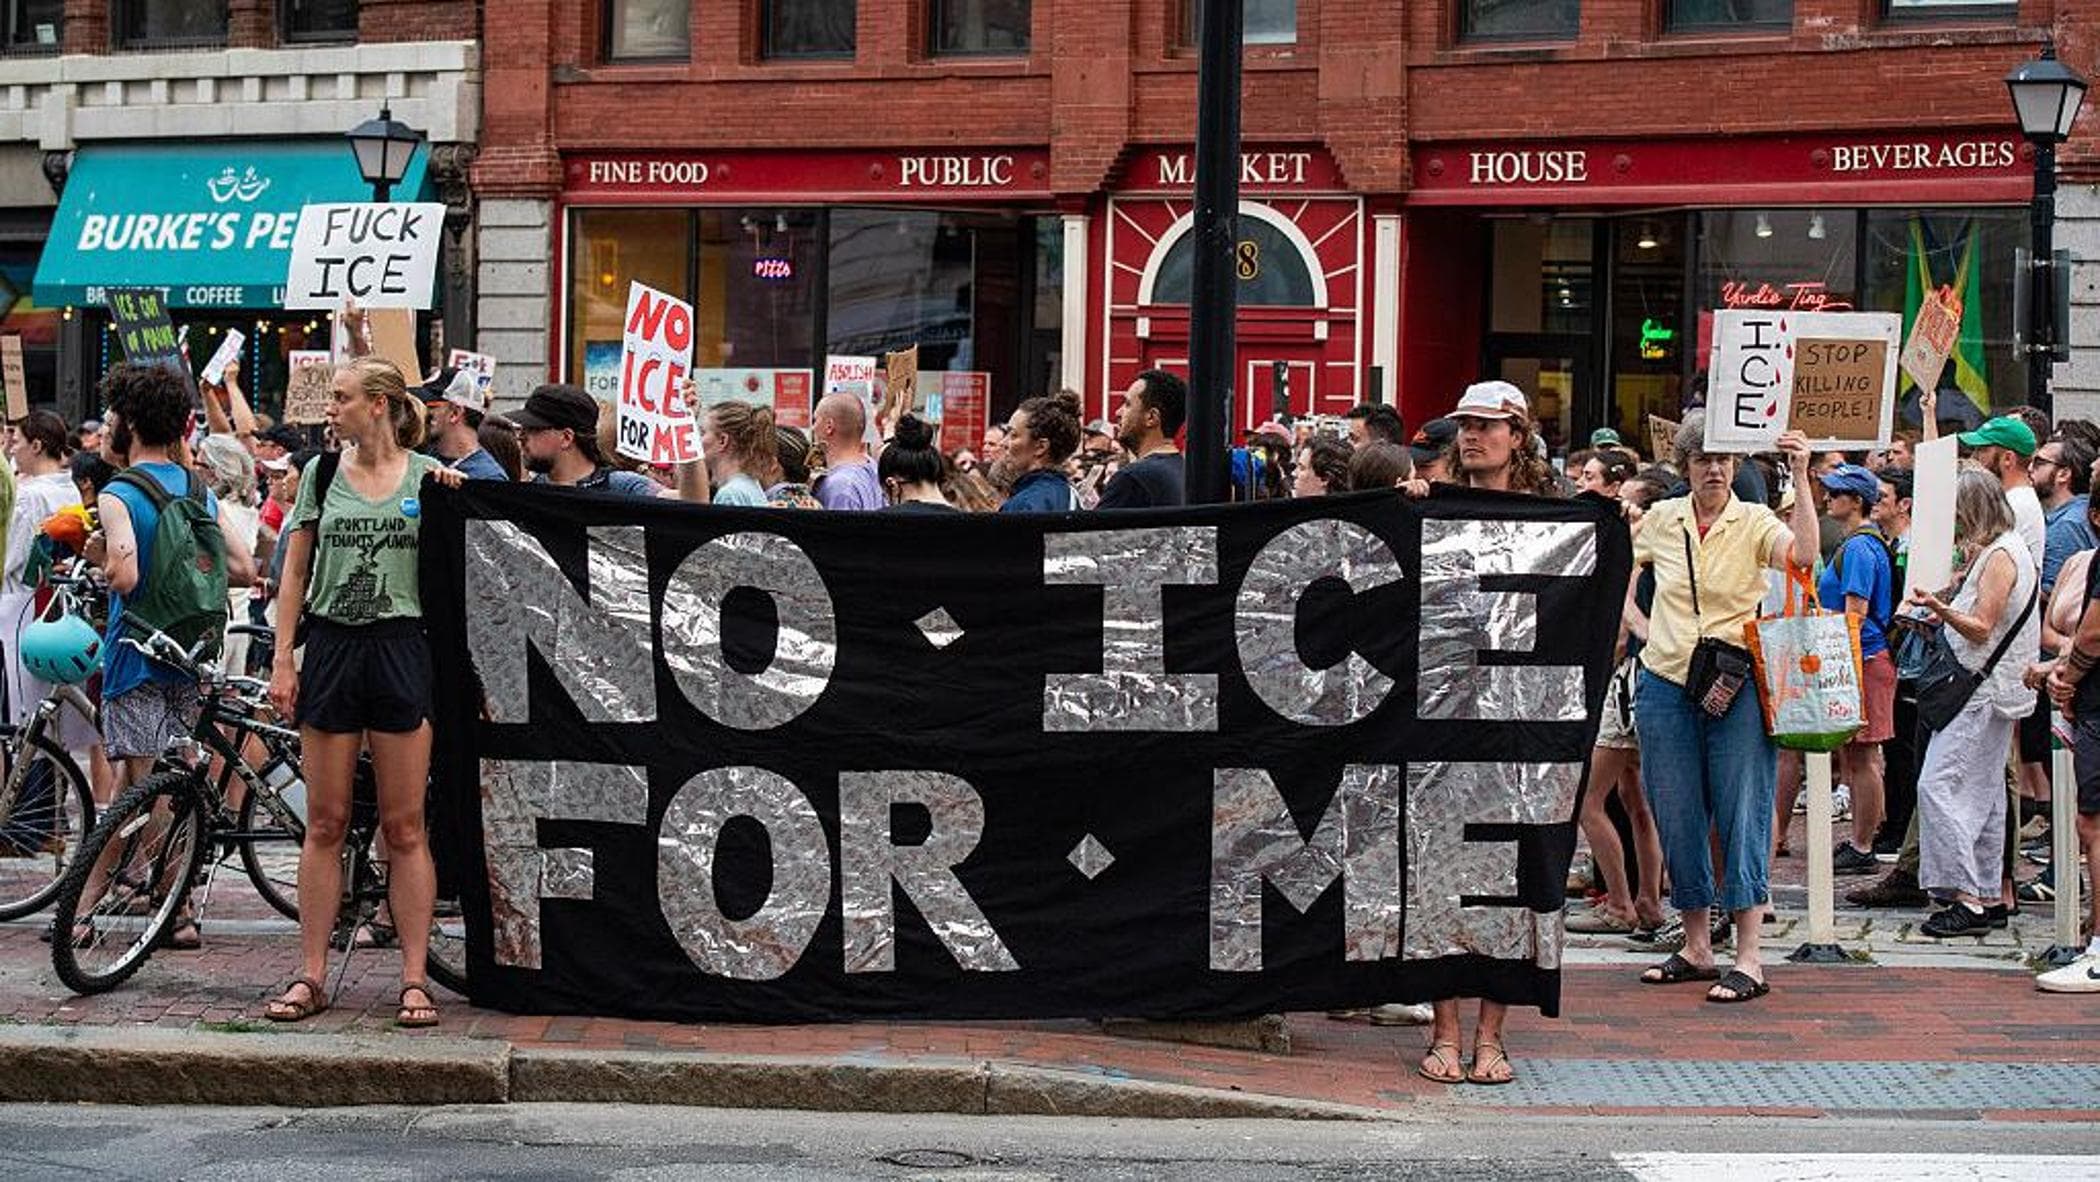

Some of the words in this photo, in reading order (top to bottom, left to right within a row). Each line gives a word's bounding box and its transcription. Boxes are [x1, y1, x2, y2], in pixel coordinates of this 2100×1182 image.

[899, 156, 1013, 186] PUBLIC
[1157, 153, 1312, 184] MKET
[1469, 151, 1588, 183] HOUSE
[1832, 141, 2015, 171] BEVERAGES
[589, 161, 643, 184] FINE
[648, 161, 709, 184] FOOD
[77, 212, 241, 251] BURKE'S
[245, 212, 299, 250] PE
[323, 207, 422, 246] FUCK
[309, 254, 411, 298] ICE
[186, 287, 243, 305] COFFEE
[627, 291, 691, 352] NO
[1804, 343, 1869, 365] STOP
[1795, 375, 1870, 394] KILLING
[1796, 400, 1873, 421] PEOPLE!
[620, 415, 649, 451] FOR
[652, 423, 698, 461] ME
[334, 518, 407, 532] PORTLAND
[465, 519, 838, 731] NO
[1043, 518, 1598, 732] ICE
[479, 757, 1023, 981] FOR
[1208, 760, 1584, 972] ME
